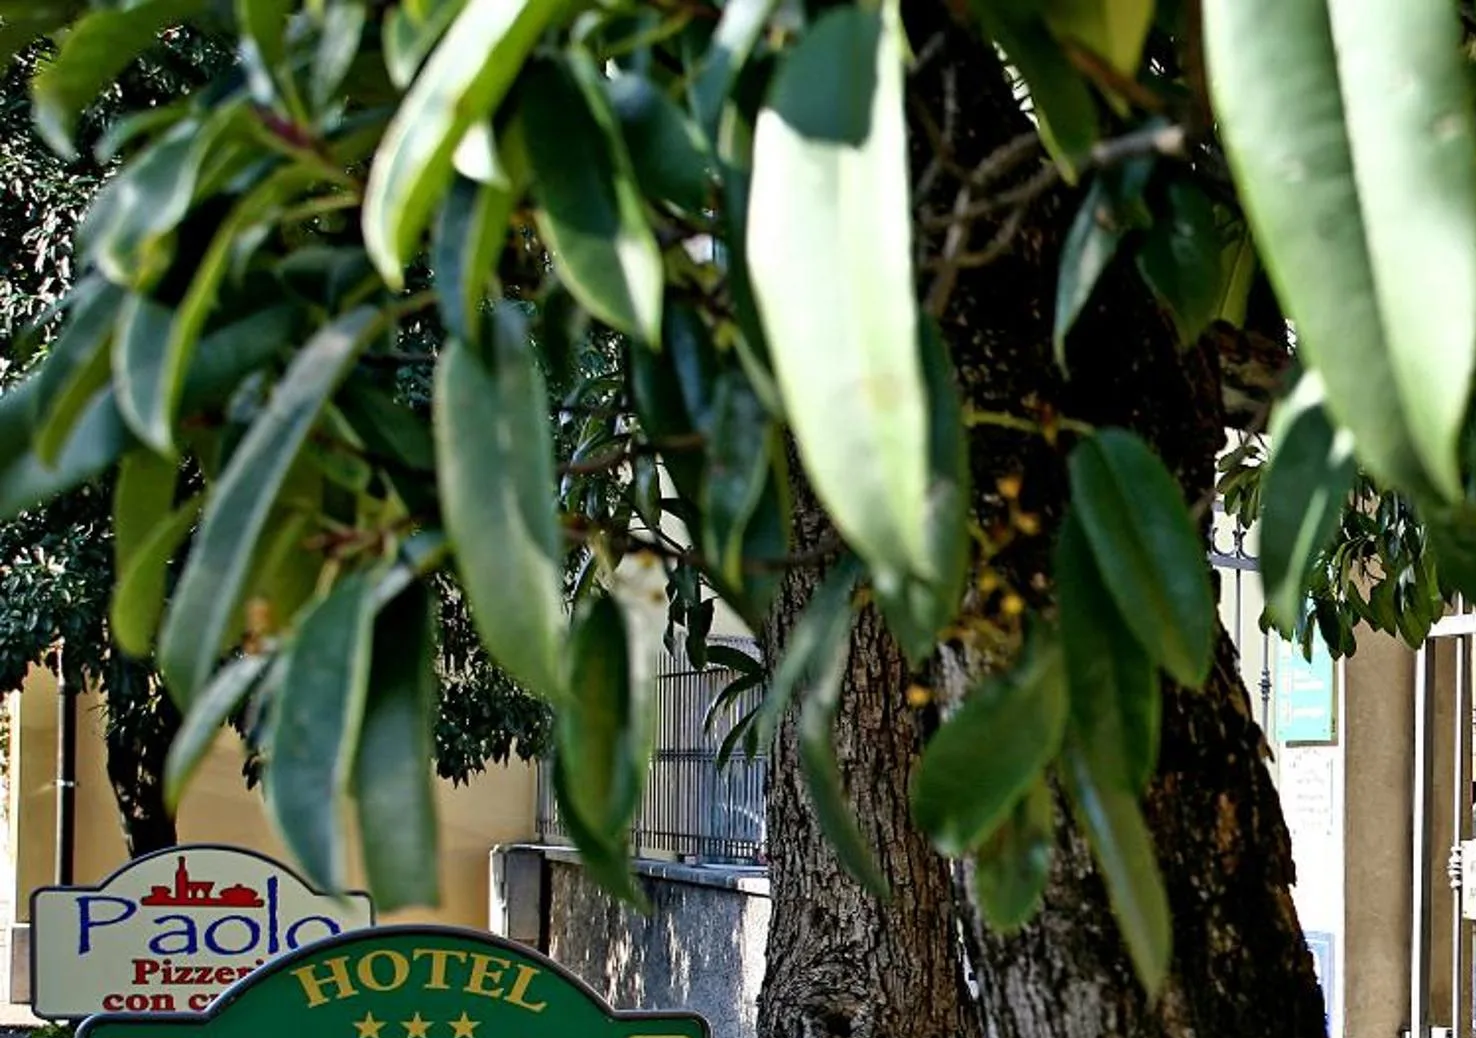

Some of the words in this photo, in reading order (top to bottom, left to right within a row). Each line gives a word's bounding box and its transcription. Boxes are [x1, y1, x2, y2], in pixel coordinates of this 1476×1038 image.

[75, 875, 342, 956] Paolo
[131, 958, 265, 985] Pizzer
[290, 948, 548, 1013] HOTEL
[102, 992, 176, 1012] con
